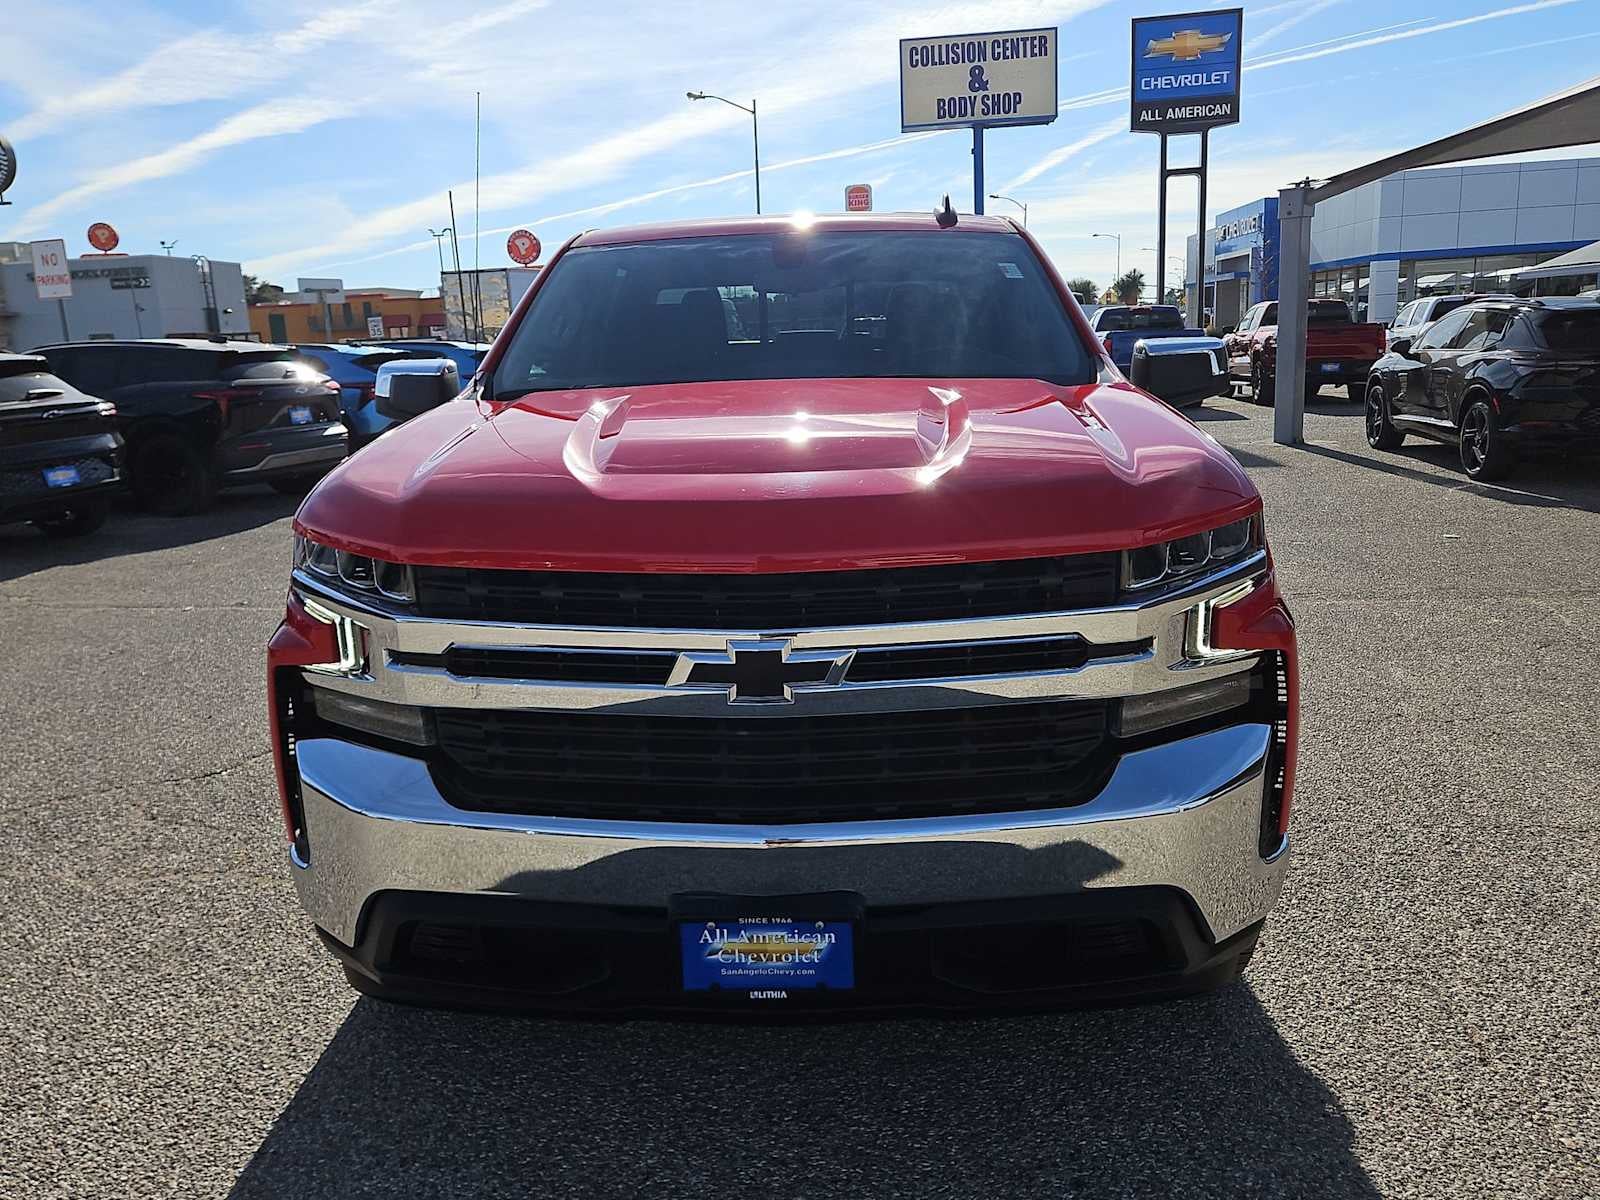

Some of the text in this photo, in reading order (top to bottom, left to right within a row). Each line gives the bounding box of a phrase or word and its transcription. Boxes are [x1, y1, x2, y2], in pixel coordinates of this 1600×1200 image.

[909, 35, 1048, 68] COLLISION CENTER
[968, 65, 989, 92] &
[1141, 71, 1231, 90] CHEVROLET
[937, 92, 1022, 119] BODY SHOP
[1140, 103, 1231, 122] ALL AMERICAN
[42, 253, 57, 266] NO
[738, 917, 768, 925] SINCE
[700, 928, 837, 944] All American
[718, 948, 820, 964] Chevrolet
[721, 968, 816, 977] SanAngeloChevy.com
